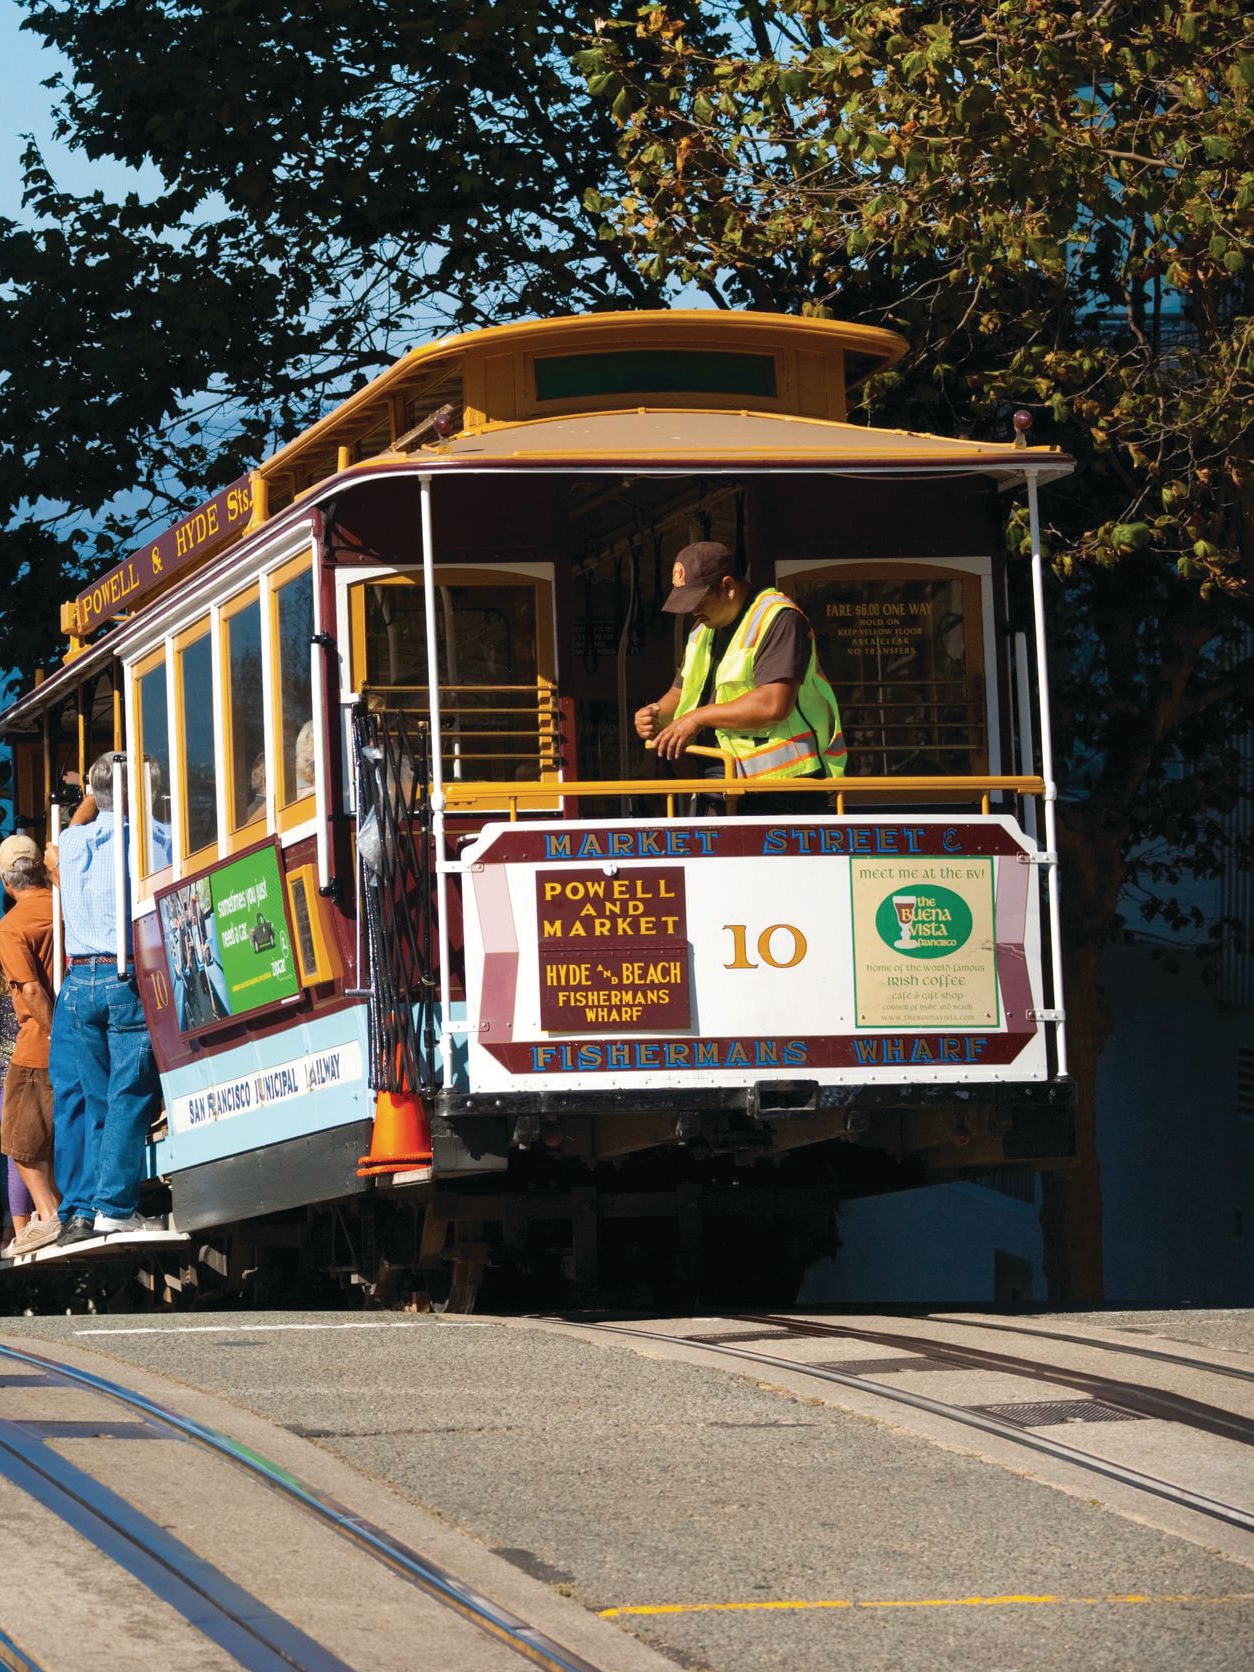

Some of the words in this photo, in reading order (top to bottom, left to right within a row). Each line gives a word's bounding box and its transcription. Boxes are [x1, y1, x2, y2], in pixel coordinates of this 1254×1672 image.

[83, 564, 140, 623] POWELL
[151, 547, 163, 574] &
[176, 504, 219, 557] HYDE
[826, 604, 852, 617] FARE
[855, 603, 879, 616] $6.00
[882, 603, 905, 616] ONE
[908, 602, 932, 615] WAY
[838, 628, 857, 636] KEEP
[865, 647, 916, 655] TRANSFERS
[544, 829, 719, 858] MARKET
[762, 828, 926, 854] STREET
[859, 868, 894, 879] meet
[898, 868, 919, 879] me
[922, 867, 936, 879] at
[940, 867, 962, 879] the
[966, 868, 985, 879] BV!
[218, 890, 246, 918] sometimes
[245, 885, 256, 912] you
[256, 877, 268, 908] just
[544, 879, 675, 901] POWELL
[580, 901, 644, 916] AND
[917, 896, 936, 906] the
[222, 921, 235, 948] need
[234, 926, 239, 943] a
[543, 916, 679, 937] MARKET
[722, 924, 808, 969] 10
[271, 956, 287, 981] zipcar
[546, 964, 591, 986] HYDE
[596, 964, 618, 985] AND
[622, 962, 681, 984] BEACH
[867, 964, 891, 972] home
[894, 964, 903, 973] of
[906, 964, 921, 972] the
[923, 963, 985, 973] world-famous
[151, 970, 168, 1009] 10
[922, 975, 966, 988] coffee
[558, 989, 669, 1007] FISHERMANS
[941, 991, 963, 1002] shop
[585, 1007, 642, 1022] WHARF
[532, 1040, 808, 1071] FISHERMANS
[853, 1037, 987, 1064] WHARF
[189, 1097, 205, 1124] SAN
